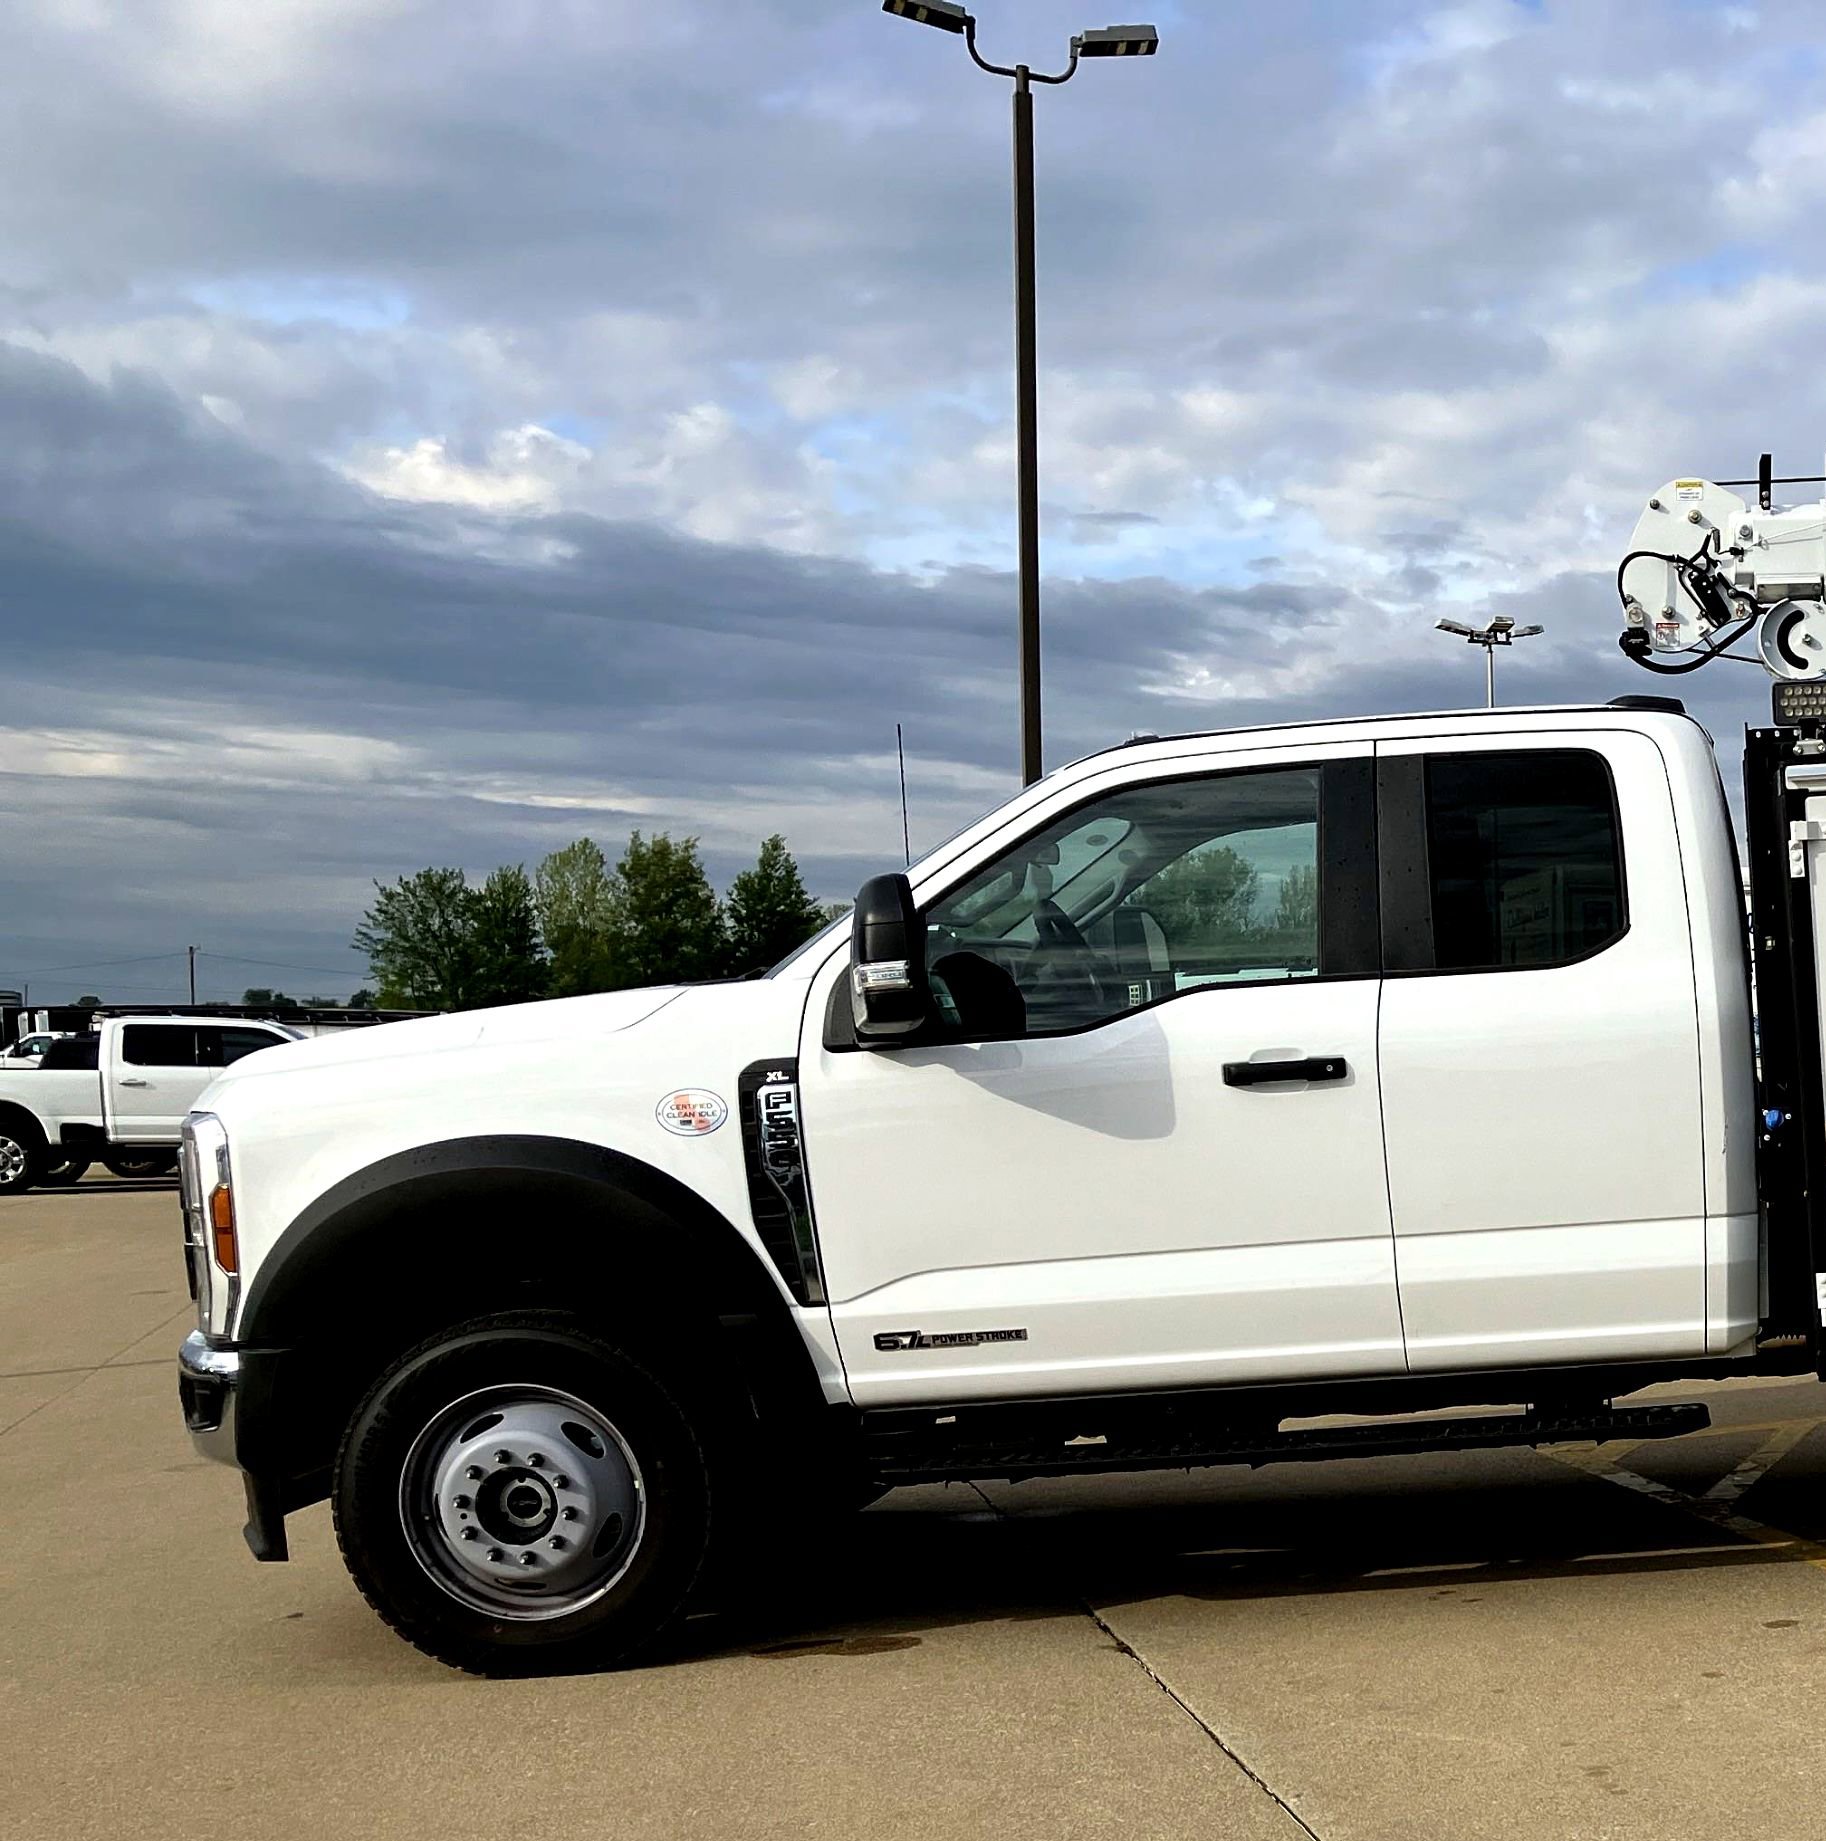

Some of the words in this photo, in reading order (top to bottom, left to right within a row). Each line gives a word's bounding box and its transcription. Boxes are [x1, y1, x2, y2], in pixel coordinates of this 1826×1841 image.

[766, 1070, 790, 1083] XL
[670, 1103, 713, 1111] CERTIFIED
[666, 1111, 695, 1119] CLEAN
[931, 1334, 973, 1345] POWER
[975, 1329, 1023, 1342] STROKE
